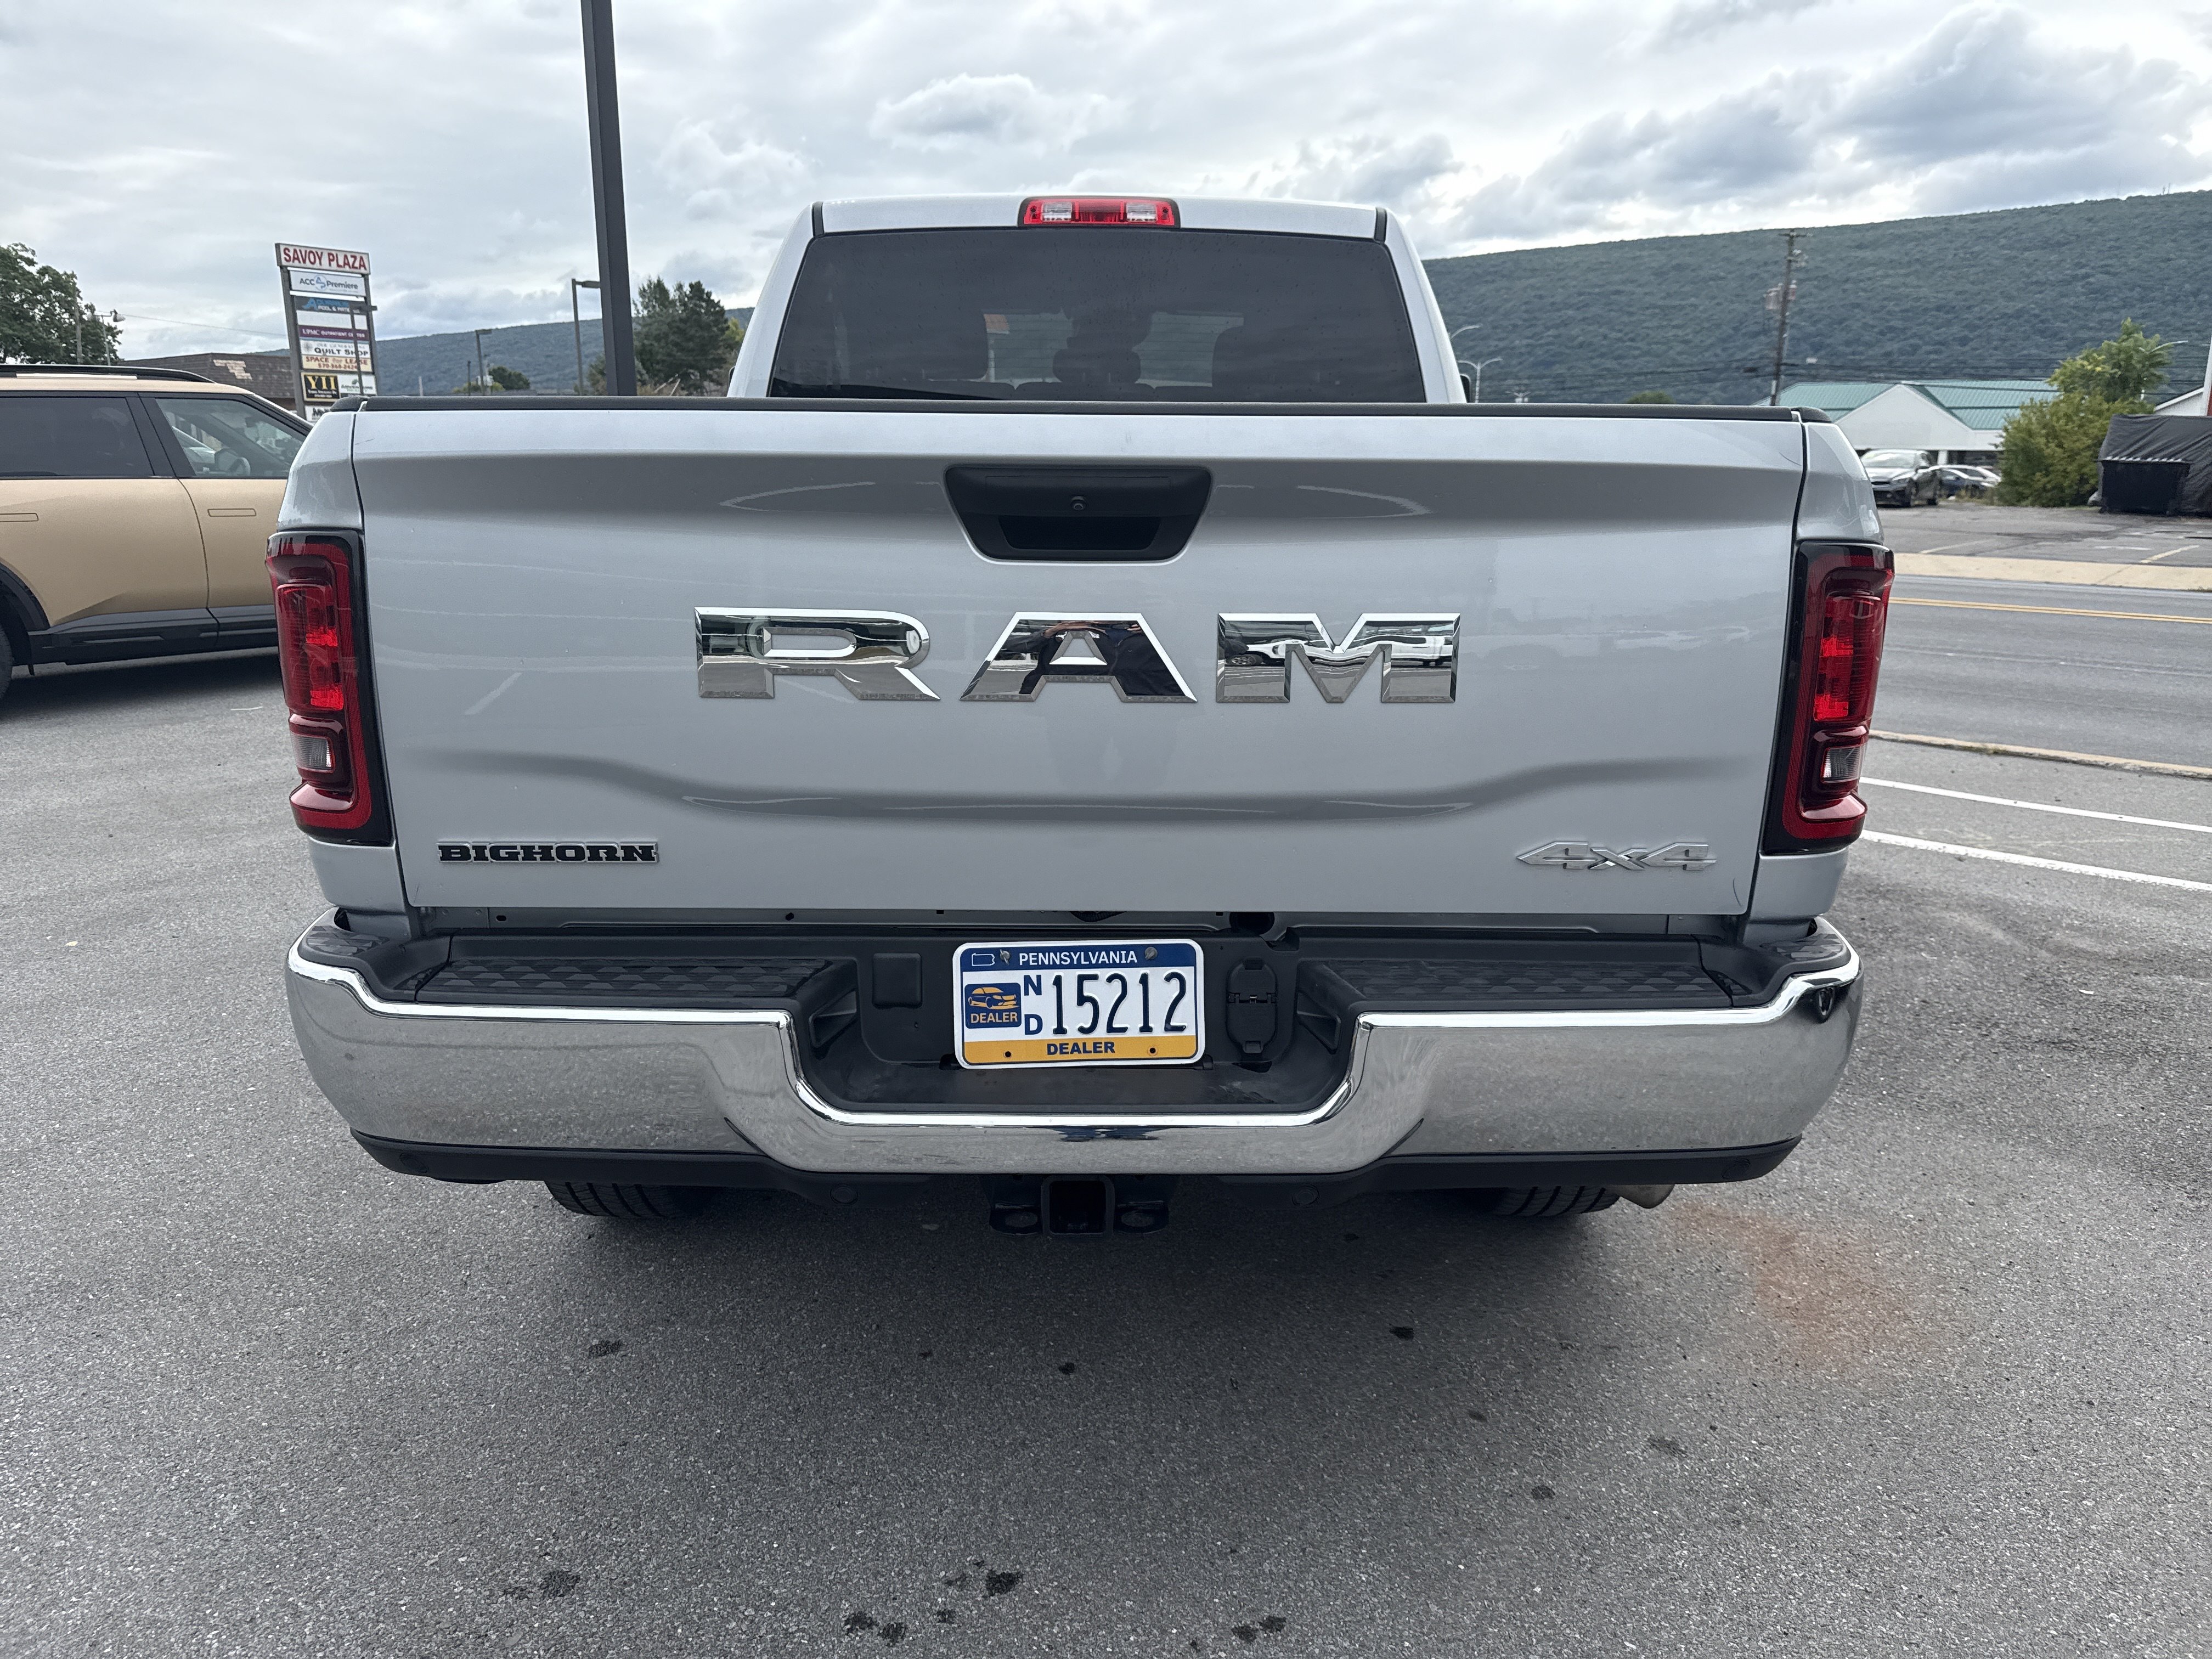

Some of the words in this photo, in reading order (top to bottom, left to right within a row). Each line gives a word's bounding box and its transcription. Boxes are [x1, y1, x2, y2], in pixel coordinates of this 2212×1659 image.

[283, 247, 323, 266] SAVOY
[328, 252, 367, 270] PLAZA
[326, 280, 358, 290] Premiere
[693, 606, 1461, 703] RAM
[436, 842, 658, 863] BIGHORN
[1019, 950, 1138, 966] PENNSYLVANIA
[1052, 971, 1187, 1035] 15212
[970, 1012, 1018, 1024] DEALER
[1046, 1041, 1116, 1056] DEALER
